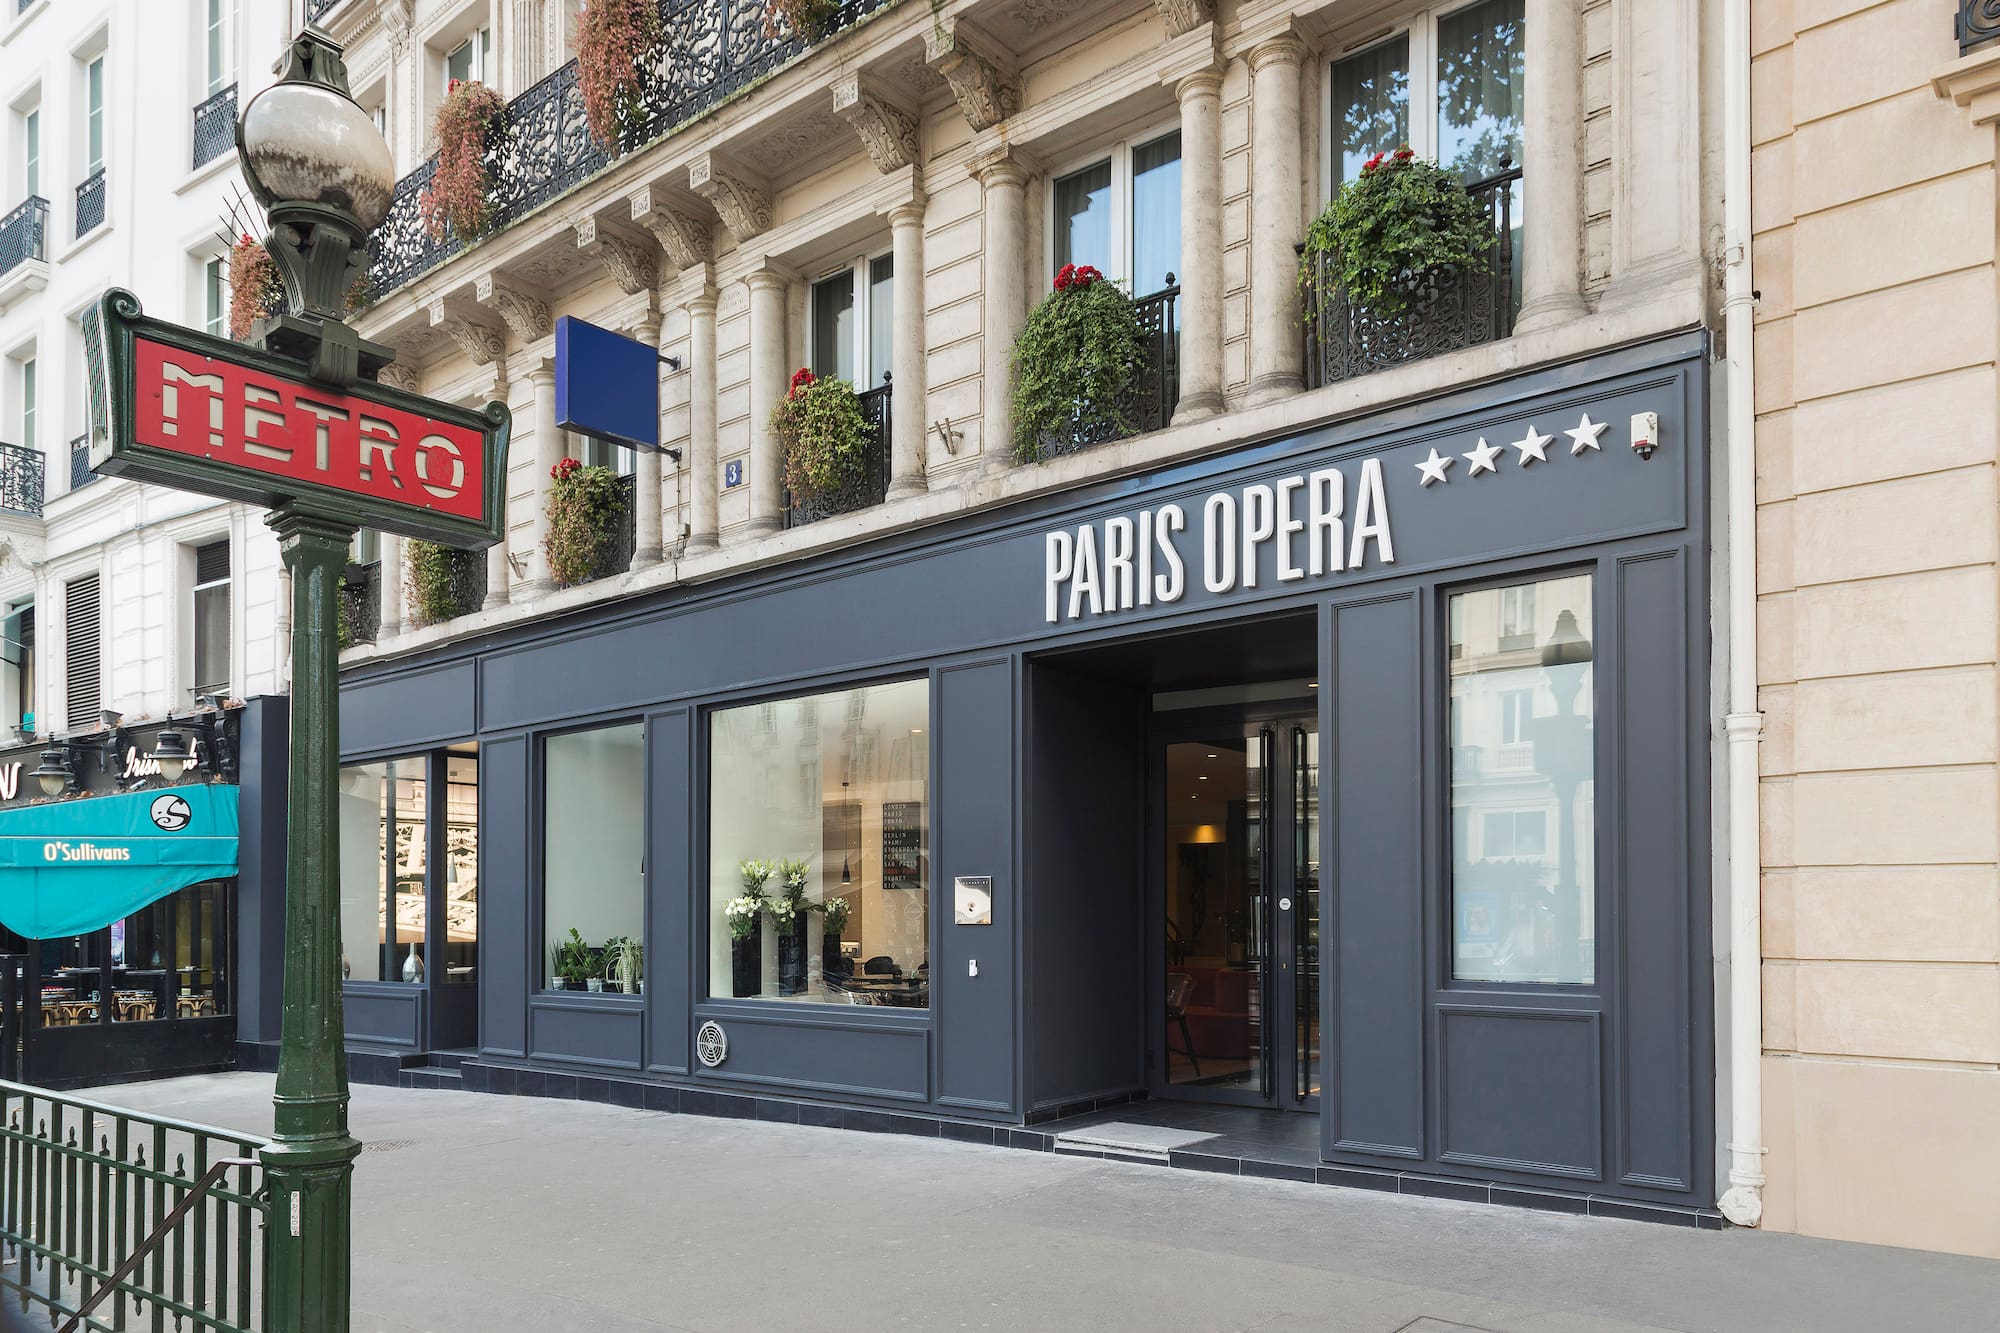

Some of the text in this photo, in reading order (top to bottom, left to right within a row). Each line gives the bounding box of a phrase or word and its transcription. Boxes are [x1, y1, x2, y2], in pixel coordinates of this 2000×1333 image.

[161, 360, 466, 500] METRO
[728, 464, 738, 483] 3
[1044, 457, 1396, 624] PARIS OPERA
[43, 841, 130, 862] O'Sullivans
